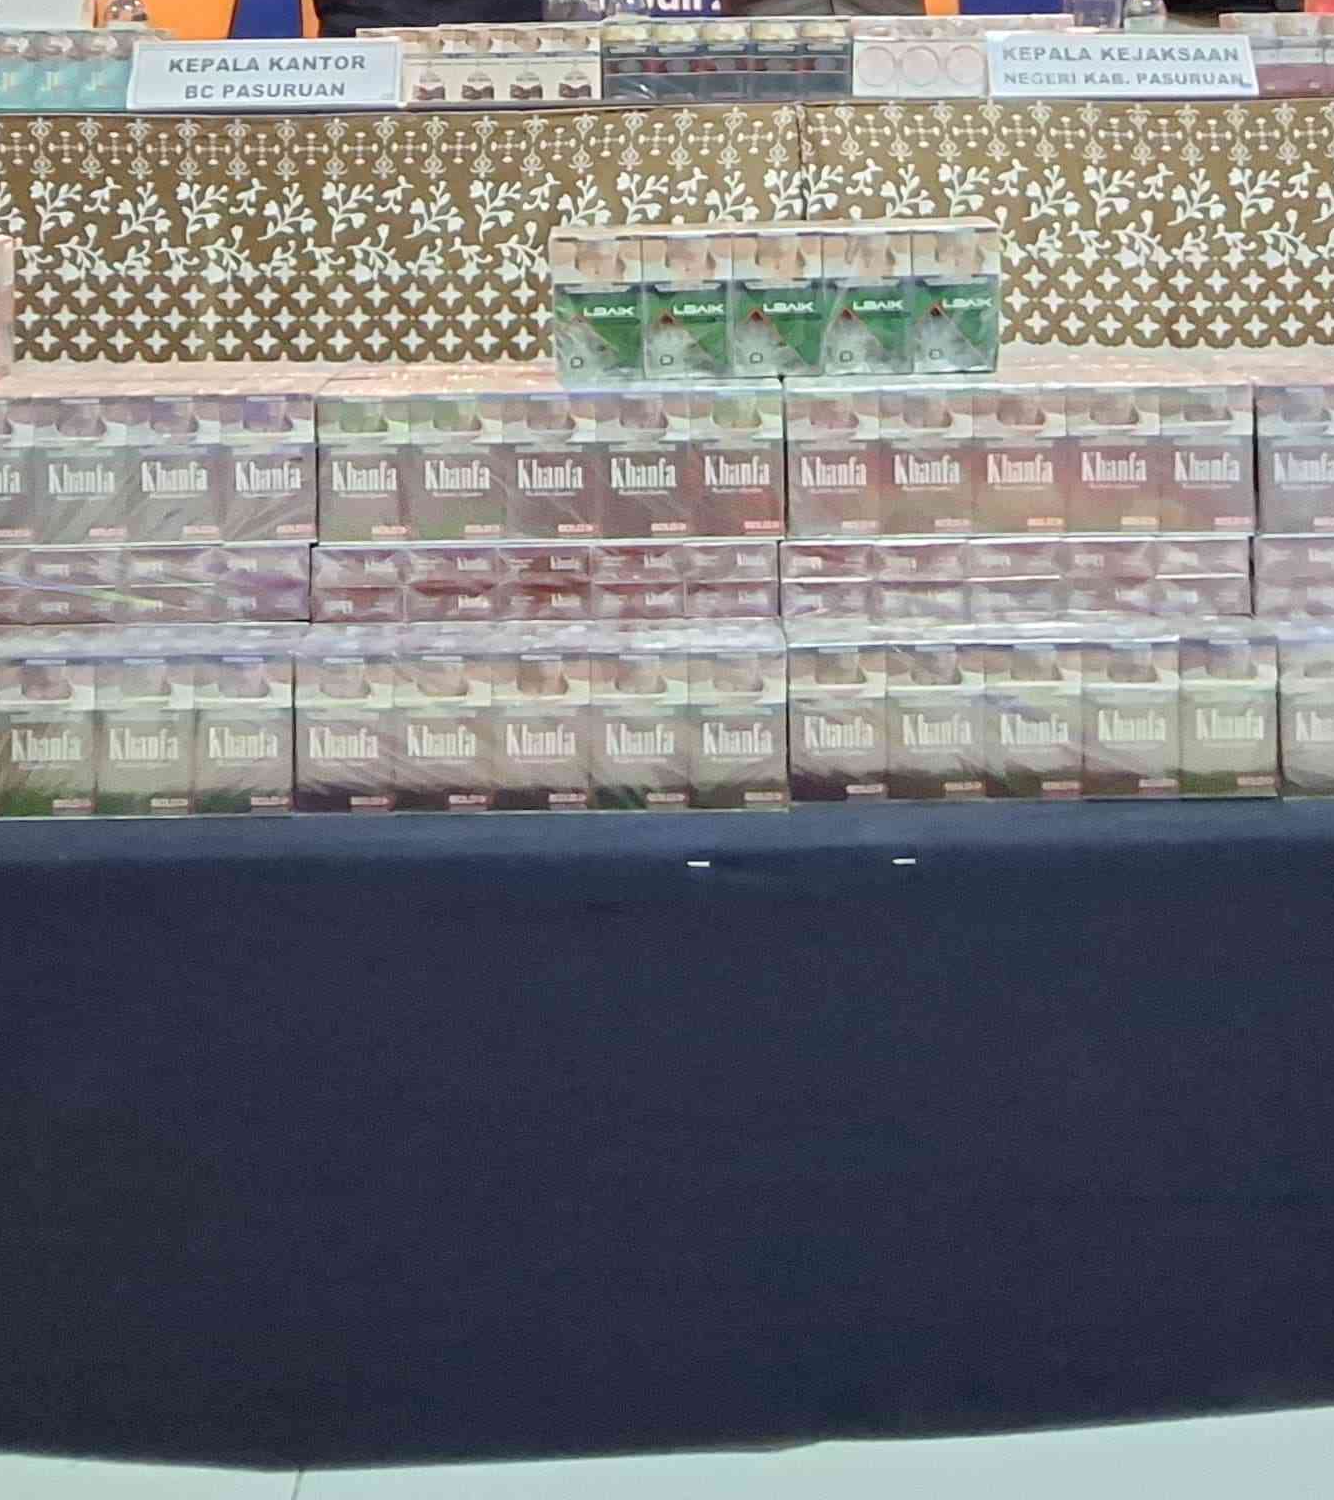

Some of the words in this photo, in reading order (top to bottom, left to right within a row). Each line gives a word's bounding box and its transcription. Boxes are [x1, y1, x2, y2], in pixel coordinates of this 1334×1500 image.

[1002, 47, 1092, 62] KEPALA
[1100, 46, 1240, 62] KEJAKSAAN
[168, 55, 260, 74] KEPALA
[269, 53, 366, 72] KANTOR
[1003, 70, 1077, 85] NEGERI
[1084, 70, 1130, 85] KAB.
[1137, 70, 1245, 86] PASURUAN
[184, 83, 214, 101] BC
[223, 81, 346, 100] PASURUAN
